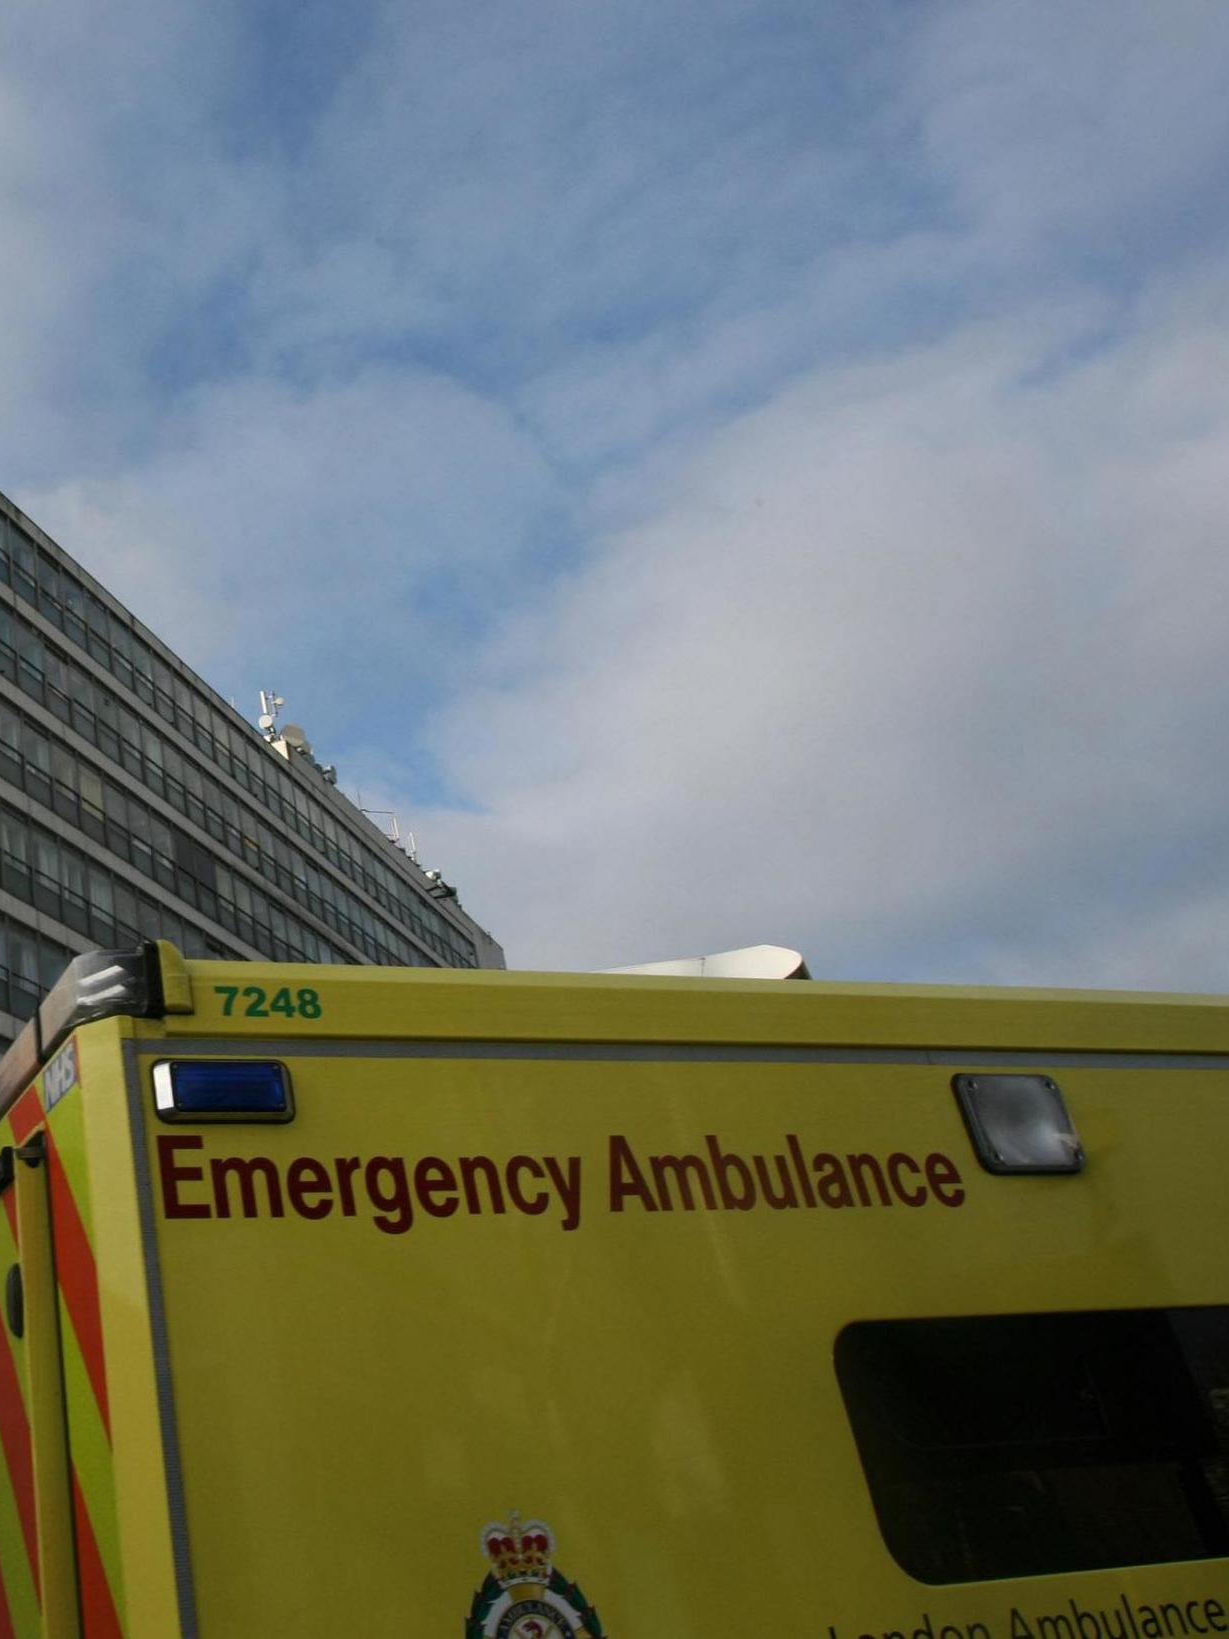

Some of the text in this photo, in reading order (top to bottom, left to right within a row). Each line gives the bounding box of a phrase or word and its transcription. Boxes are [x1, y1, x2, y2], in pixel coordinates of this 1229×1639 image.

[213, 985, 322, 1019] 7248
[155, 1134, 966, 1235] Emergency Ambulance
[1009, 1593, 1228, 1639] Ambulance
